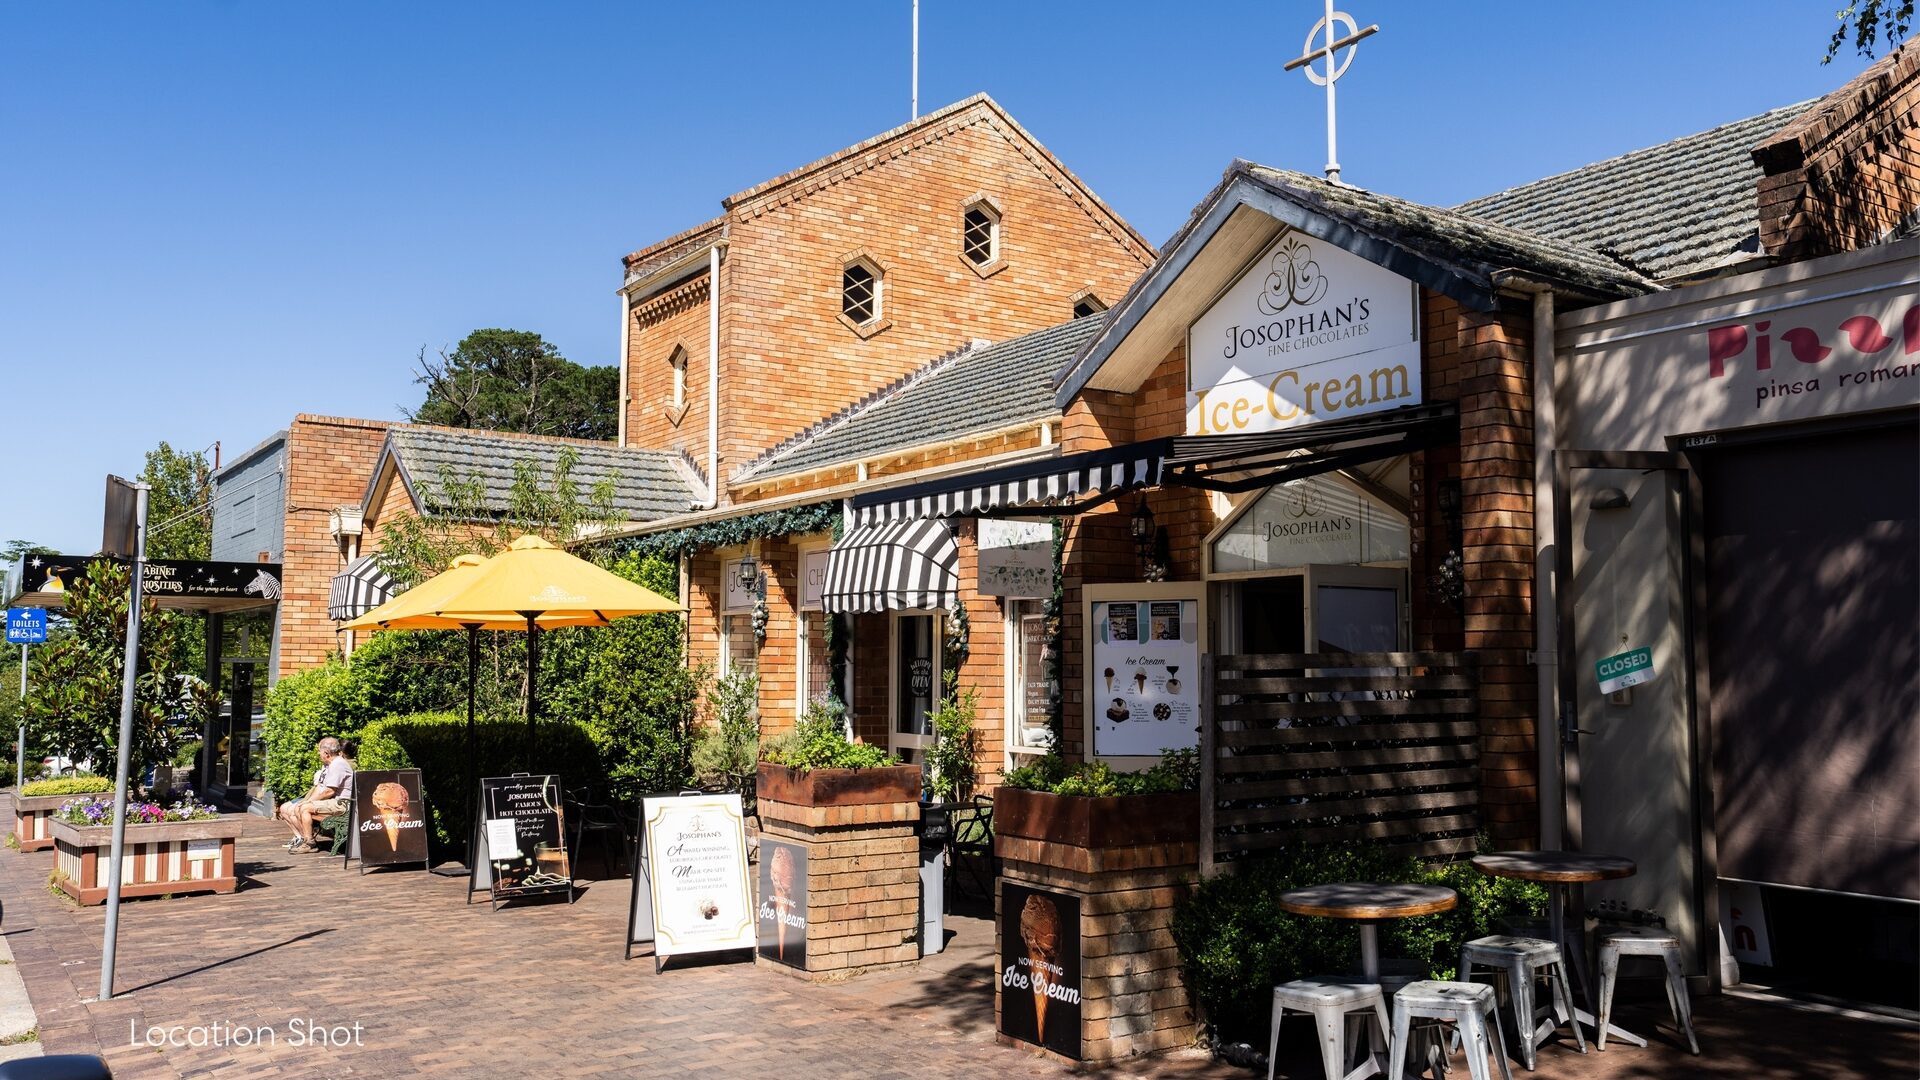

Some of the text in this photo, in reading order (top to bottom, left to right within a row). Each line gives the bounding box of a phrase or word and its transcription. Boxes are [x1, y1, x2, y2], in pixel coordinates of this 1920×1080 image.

[1223, 297, 1370, 359] JOSOPHAN'S
[1267, 323, 1370, 357] FINE CHOCOLATES
[1195, 363, 1412, 436] Ice-Cream
[1756, 378, 1820, 408] pinsa
[1262, 516, 1352, 542] JOSOPHAN'S
[143, 563, 177, 579] ABINET
[12, 620, 40, 628] TOILETS
[1125, 655, 1167, 666] Ice Cream
[1599, 652, 1648, 676] CLOSED
[360, 818, 424, 832] Ice Cream
[760, 900, 806, 930] Ice Cream
[1018, 956, 1064, 977] NOW SERVING
[1002, 964, 1081, 1006] Ice Cream
